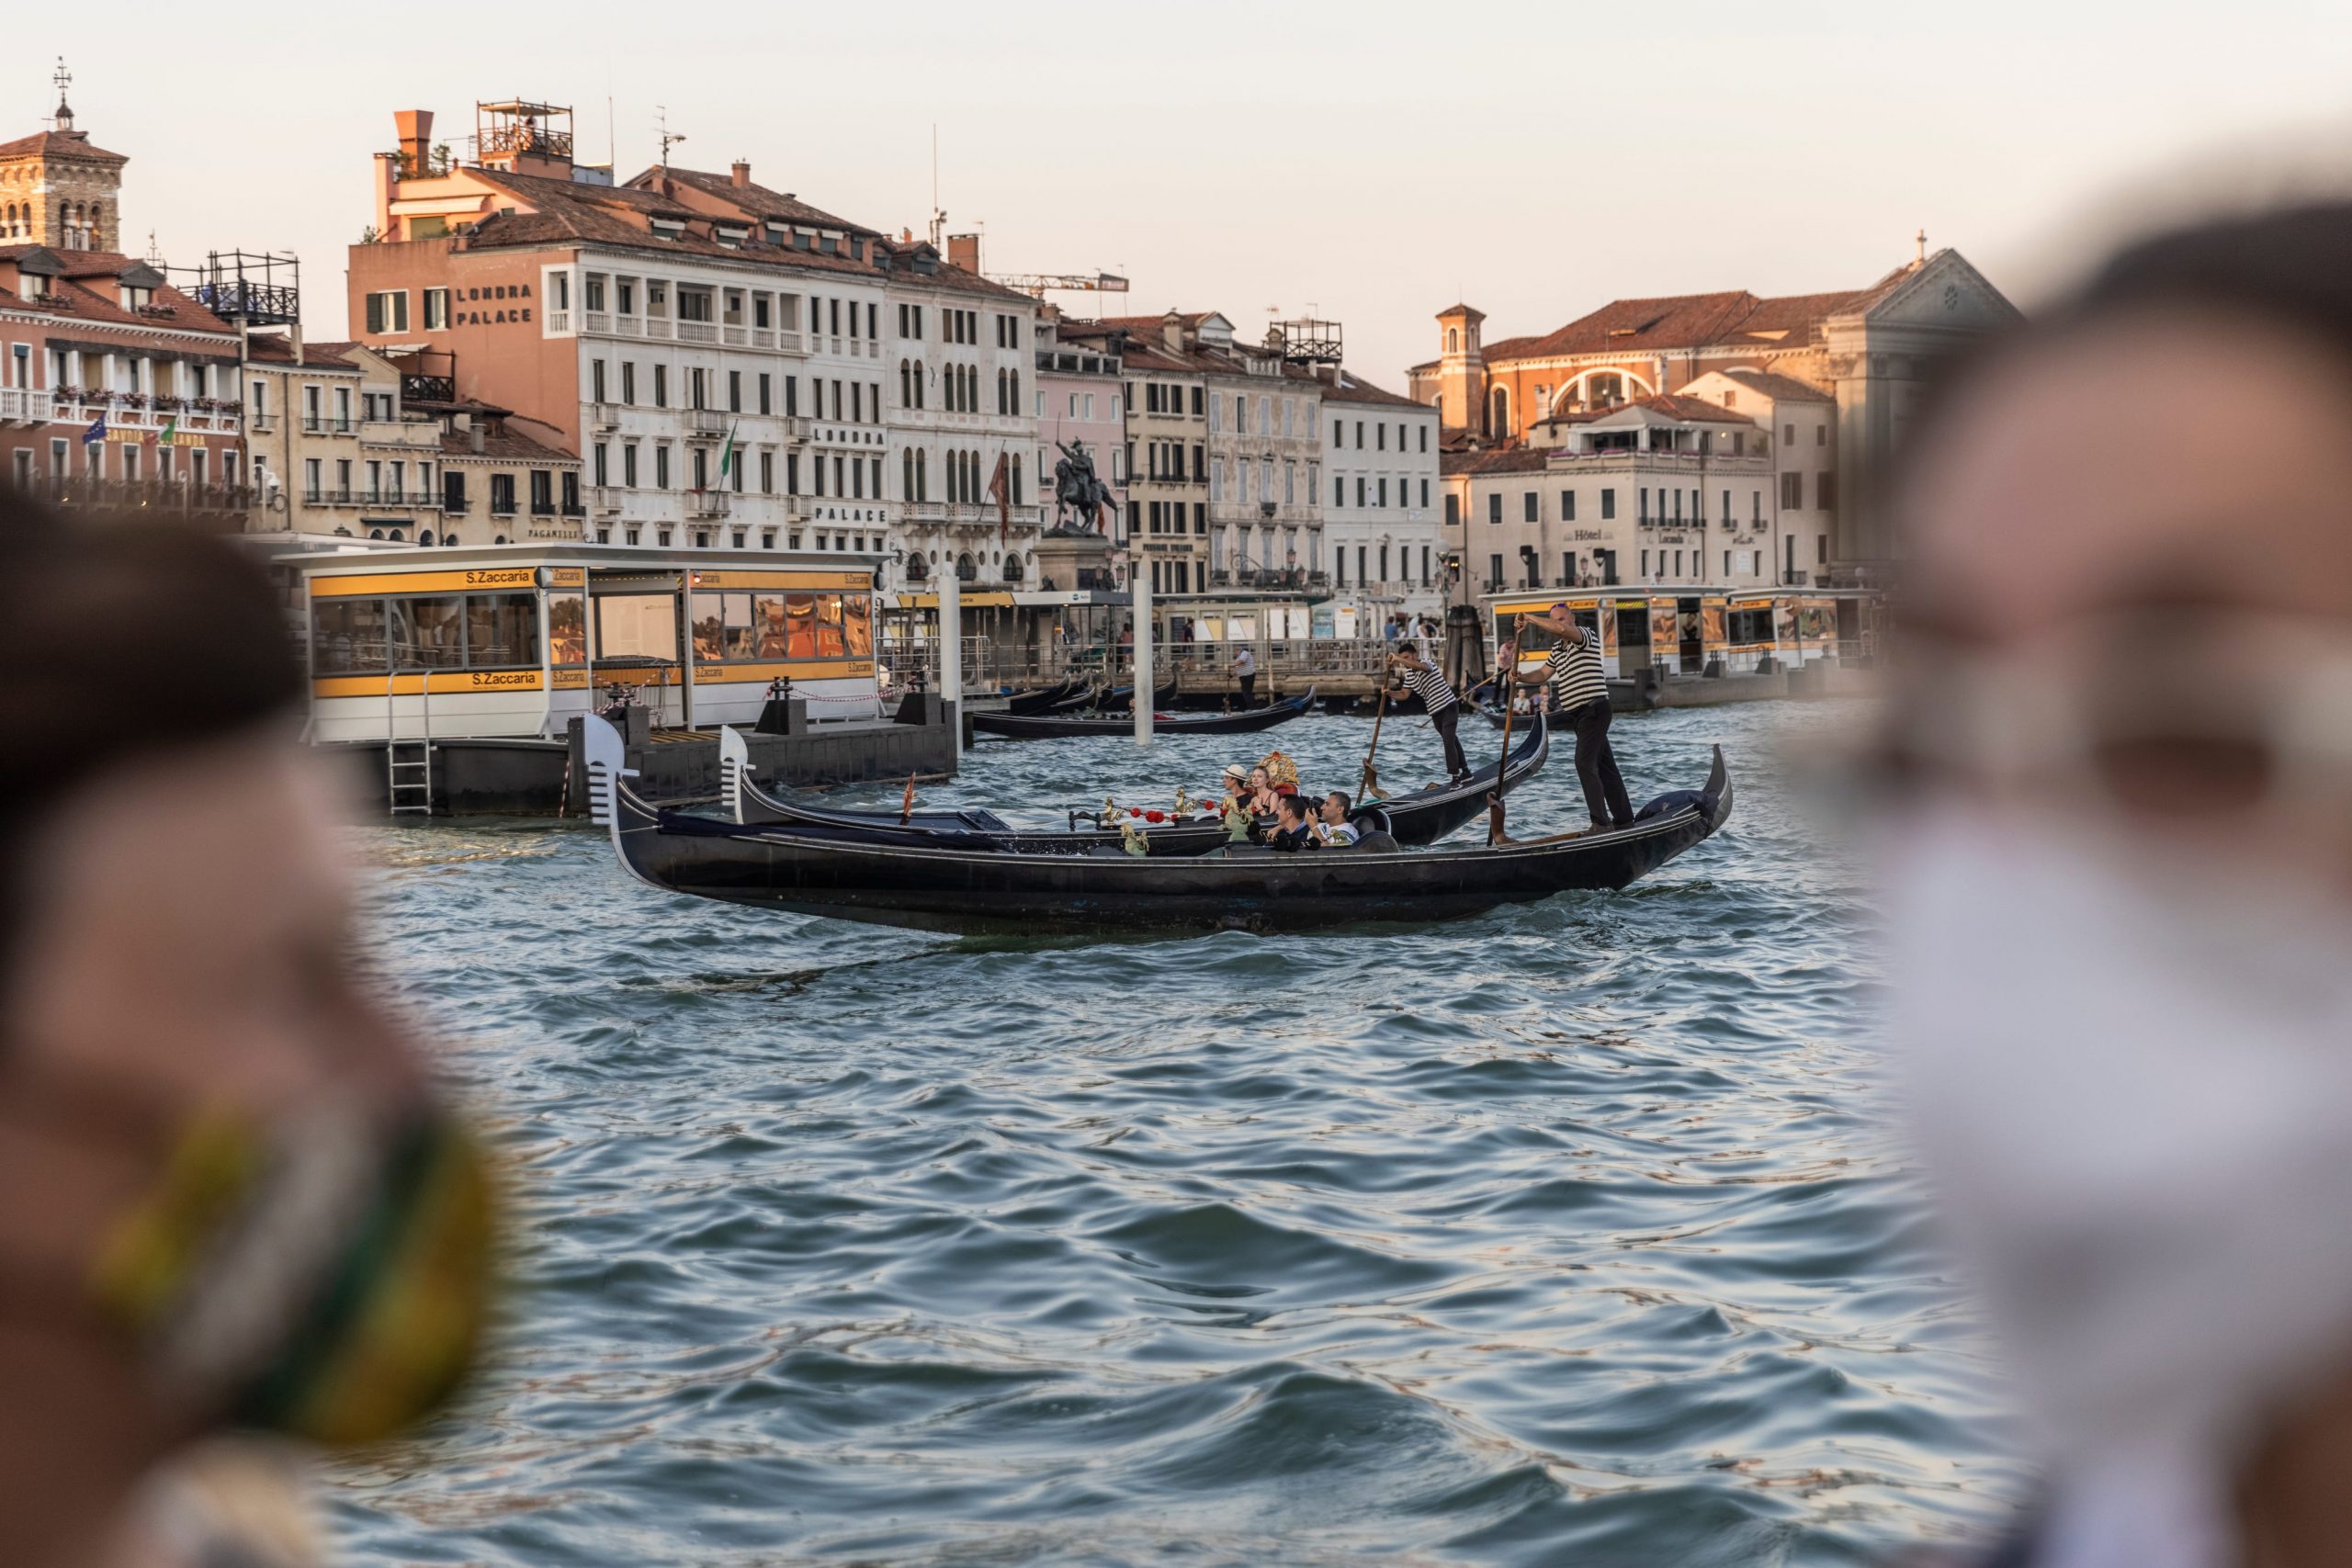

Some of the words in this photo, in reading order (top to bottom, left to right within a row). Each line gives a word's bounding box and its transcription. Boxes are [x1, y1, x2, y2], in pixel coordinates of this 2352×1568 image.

[457, 284, 532, 302] LONDRA
[457, 309, 532, 326] PALACE
[106, 428, 145, 444] SAVOIA
[814, 428, 884, 445] LONDRA
[816, 507, 886, 522] PALACE
[528, 529, 577, 539] PAGANELLI
[466, 570, 529, 584] S.Zaccaria
[553, 569, 580, 581] Zaccaria
[472, 671, 536, 685] S.Zaccaria
[552, 671, 584, 682] S.Zaccaria
